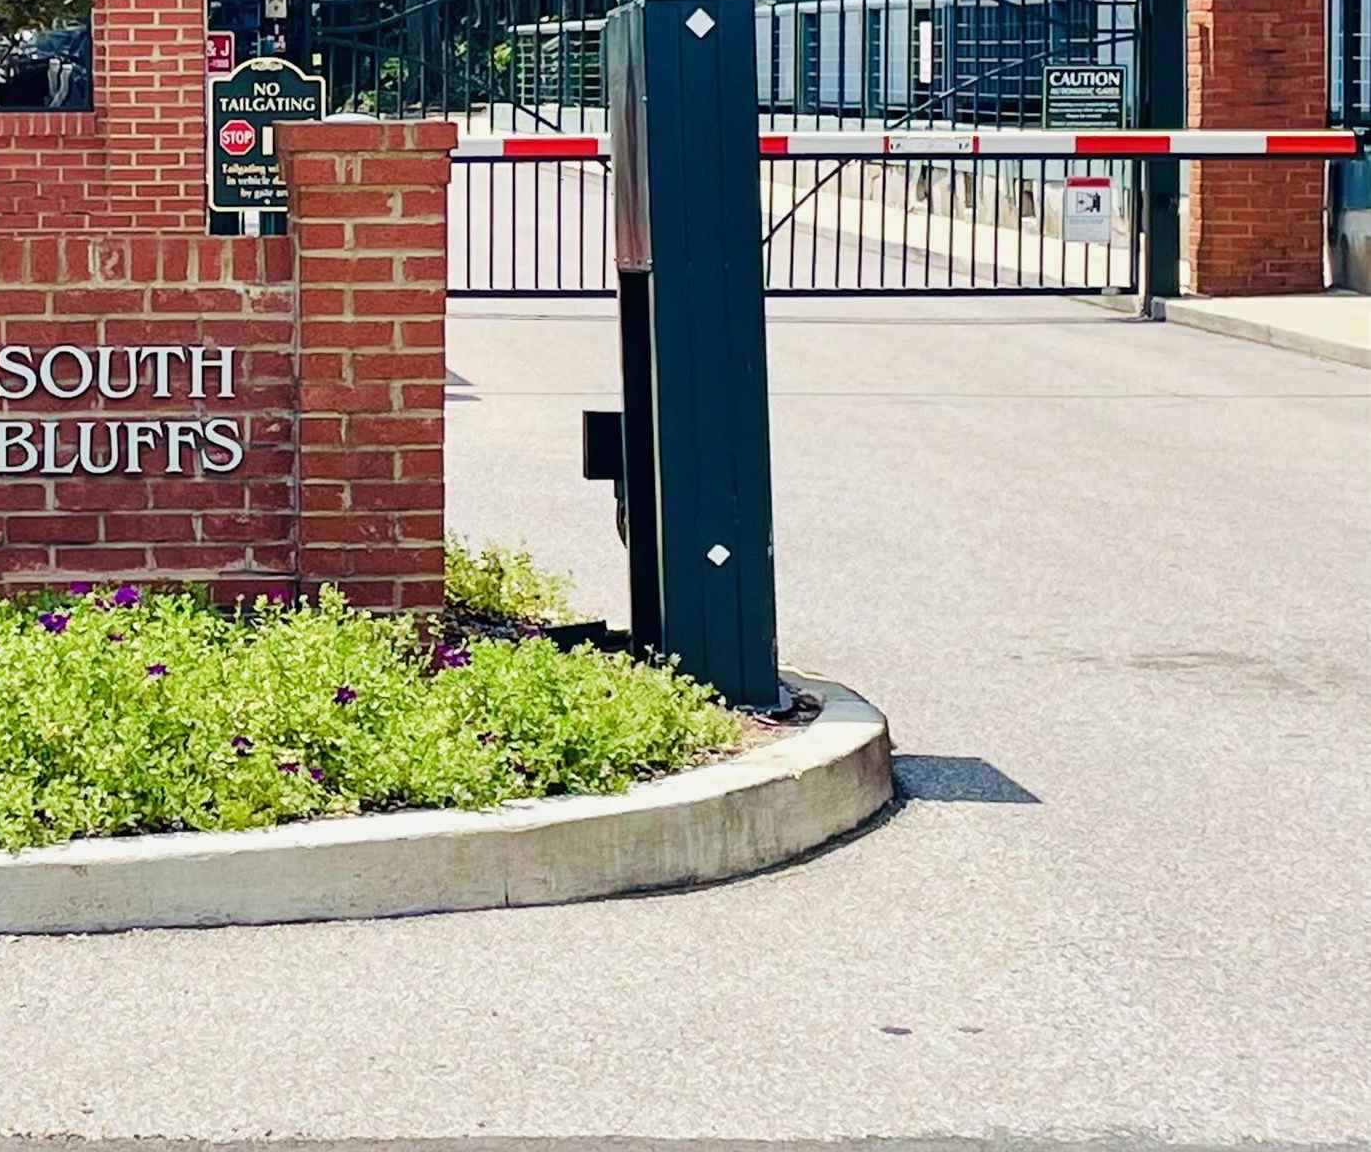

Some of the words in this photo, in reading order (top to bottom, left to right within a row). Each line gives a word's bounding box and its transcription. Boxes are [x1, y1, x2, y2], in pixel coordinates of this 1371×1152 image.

[1049, 71, 1121, 87] CAUTION
[253, 82, 281, 97] NO
[219, 97, 316, 112] TAILGATING
[222, 130, 253, 145] STOP
